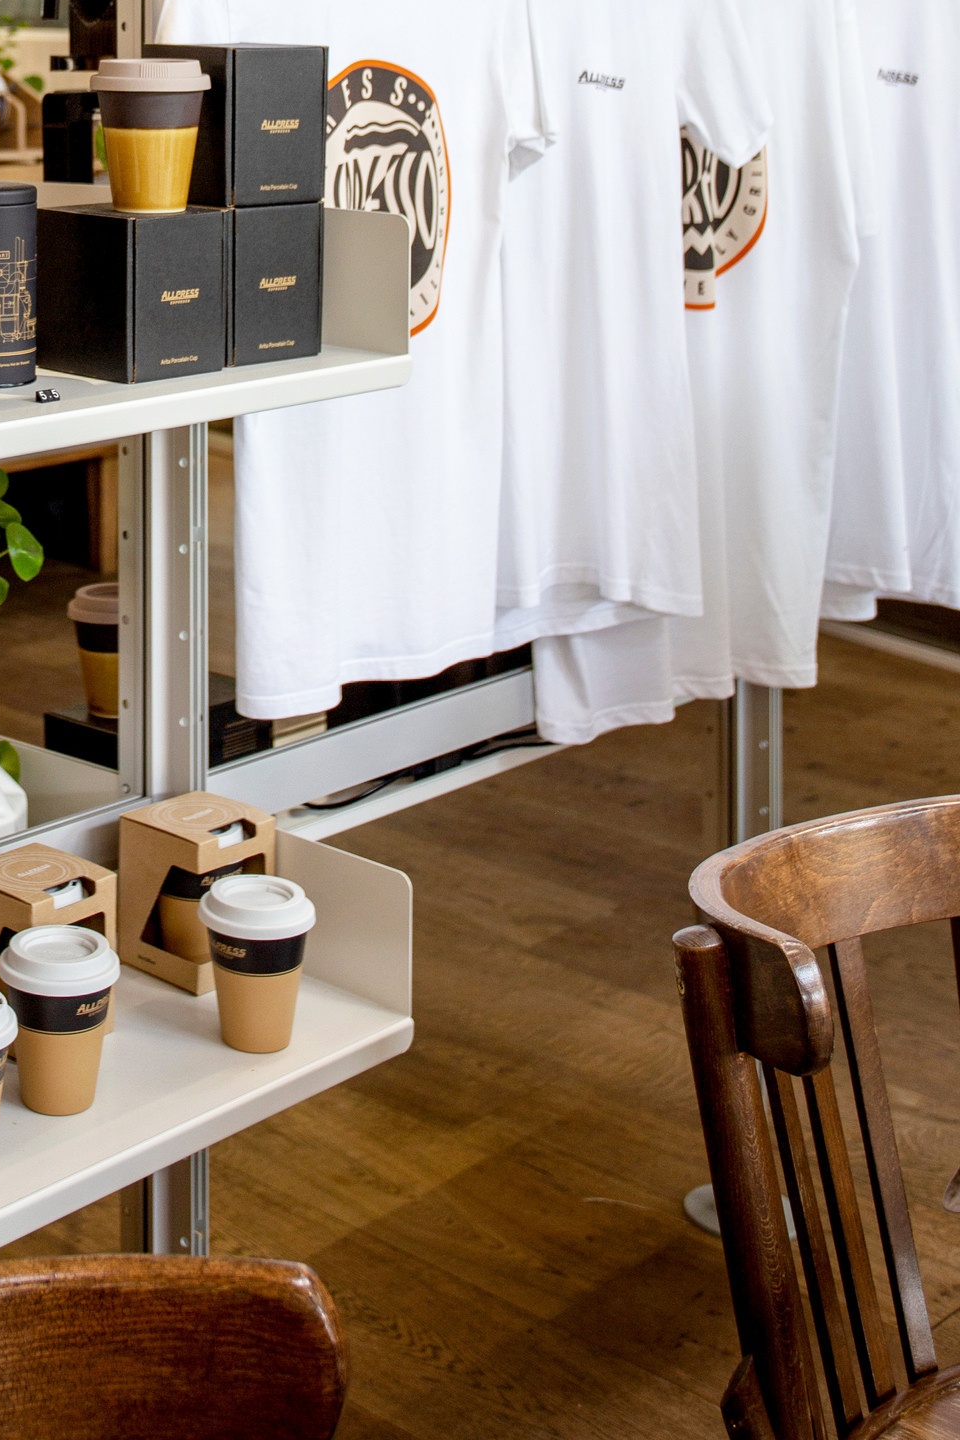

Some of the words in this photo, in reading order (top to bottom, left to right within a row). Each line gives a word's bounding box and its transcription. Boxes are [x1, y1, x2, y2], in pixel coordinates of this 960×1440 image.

[260, 118, 300, 131] ALLPRESS
[259, 275, 297, 289] ALLPRESS
[161, 287, 200, 303] ALLPRESS
[212, 940, 247, 959] PRESS
